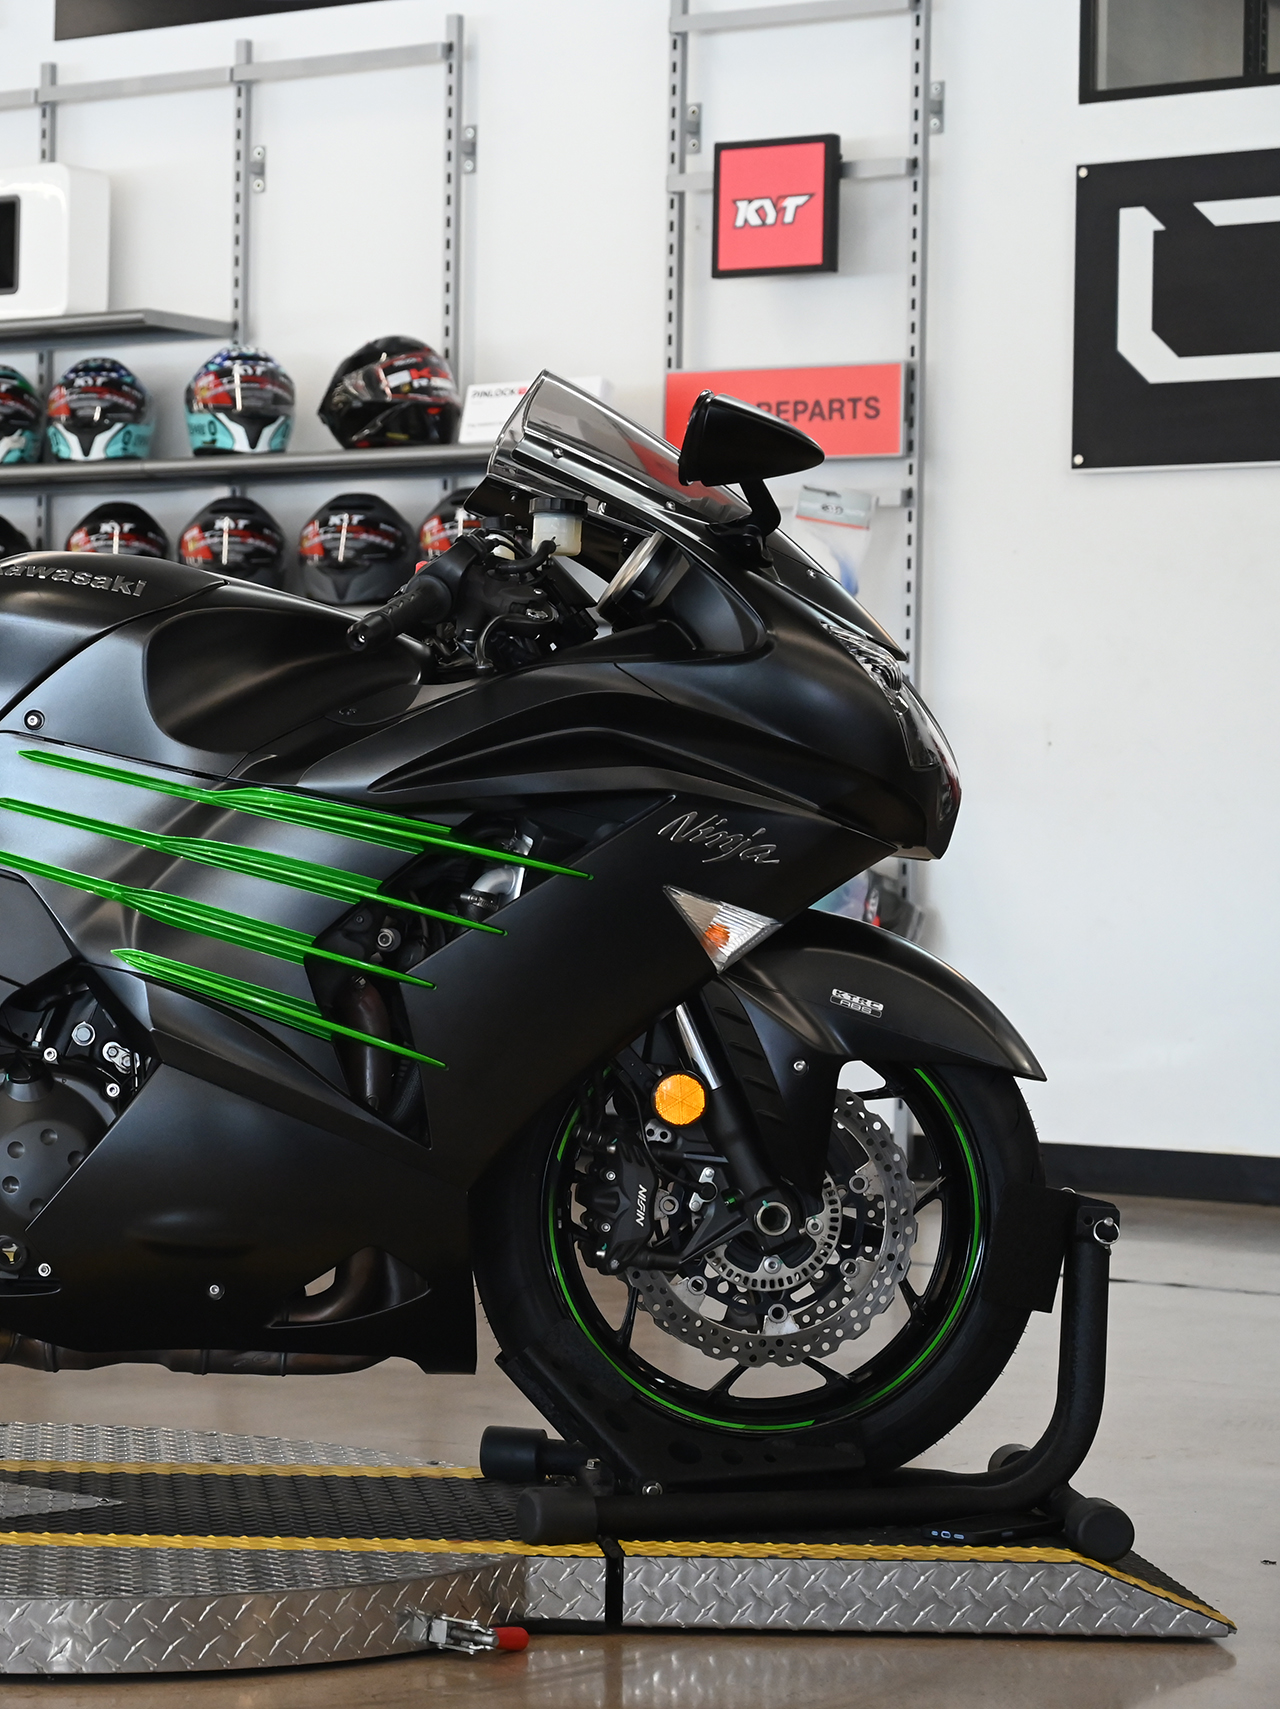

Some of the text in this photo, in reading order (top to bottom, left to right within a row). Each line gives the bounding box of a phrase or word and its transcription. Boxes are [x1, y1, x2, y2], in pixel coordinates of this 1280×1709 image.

[732, 192, 816, 229] KYT
[657, 811, 781, 865] Ninja
[835, 990, 881, 1010] KTRC
[840, 999, 872, 1015] ABS
[635, 1184, 647, 1227] NISSIN
